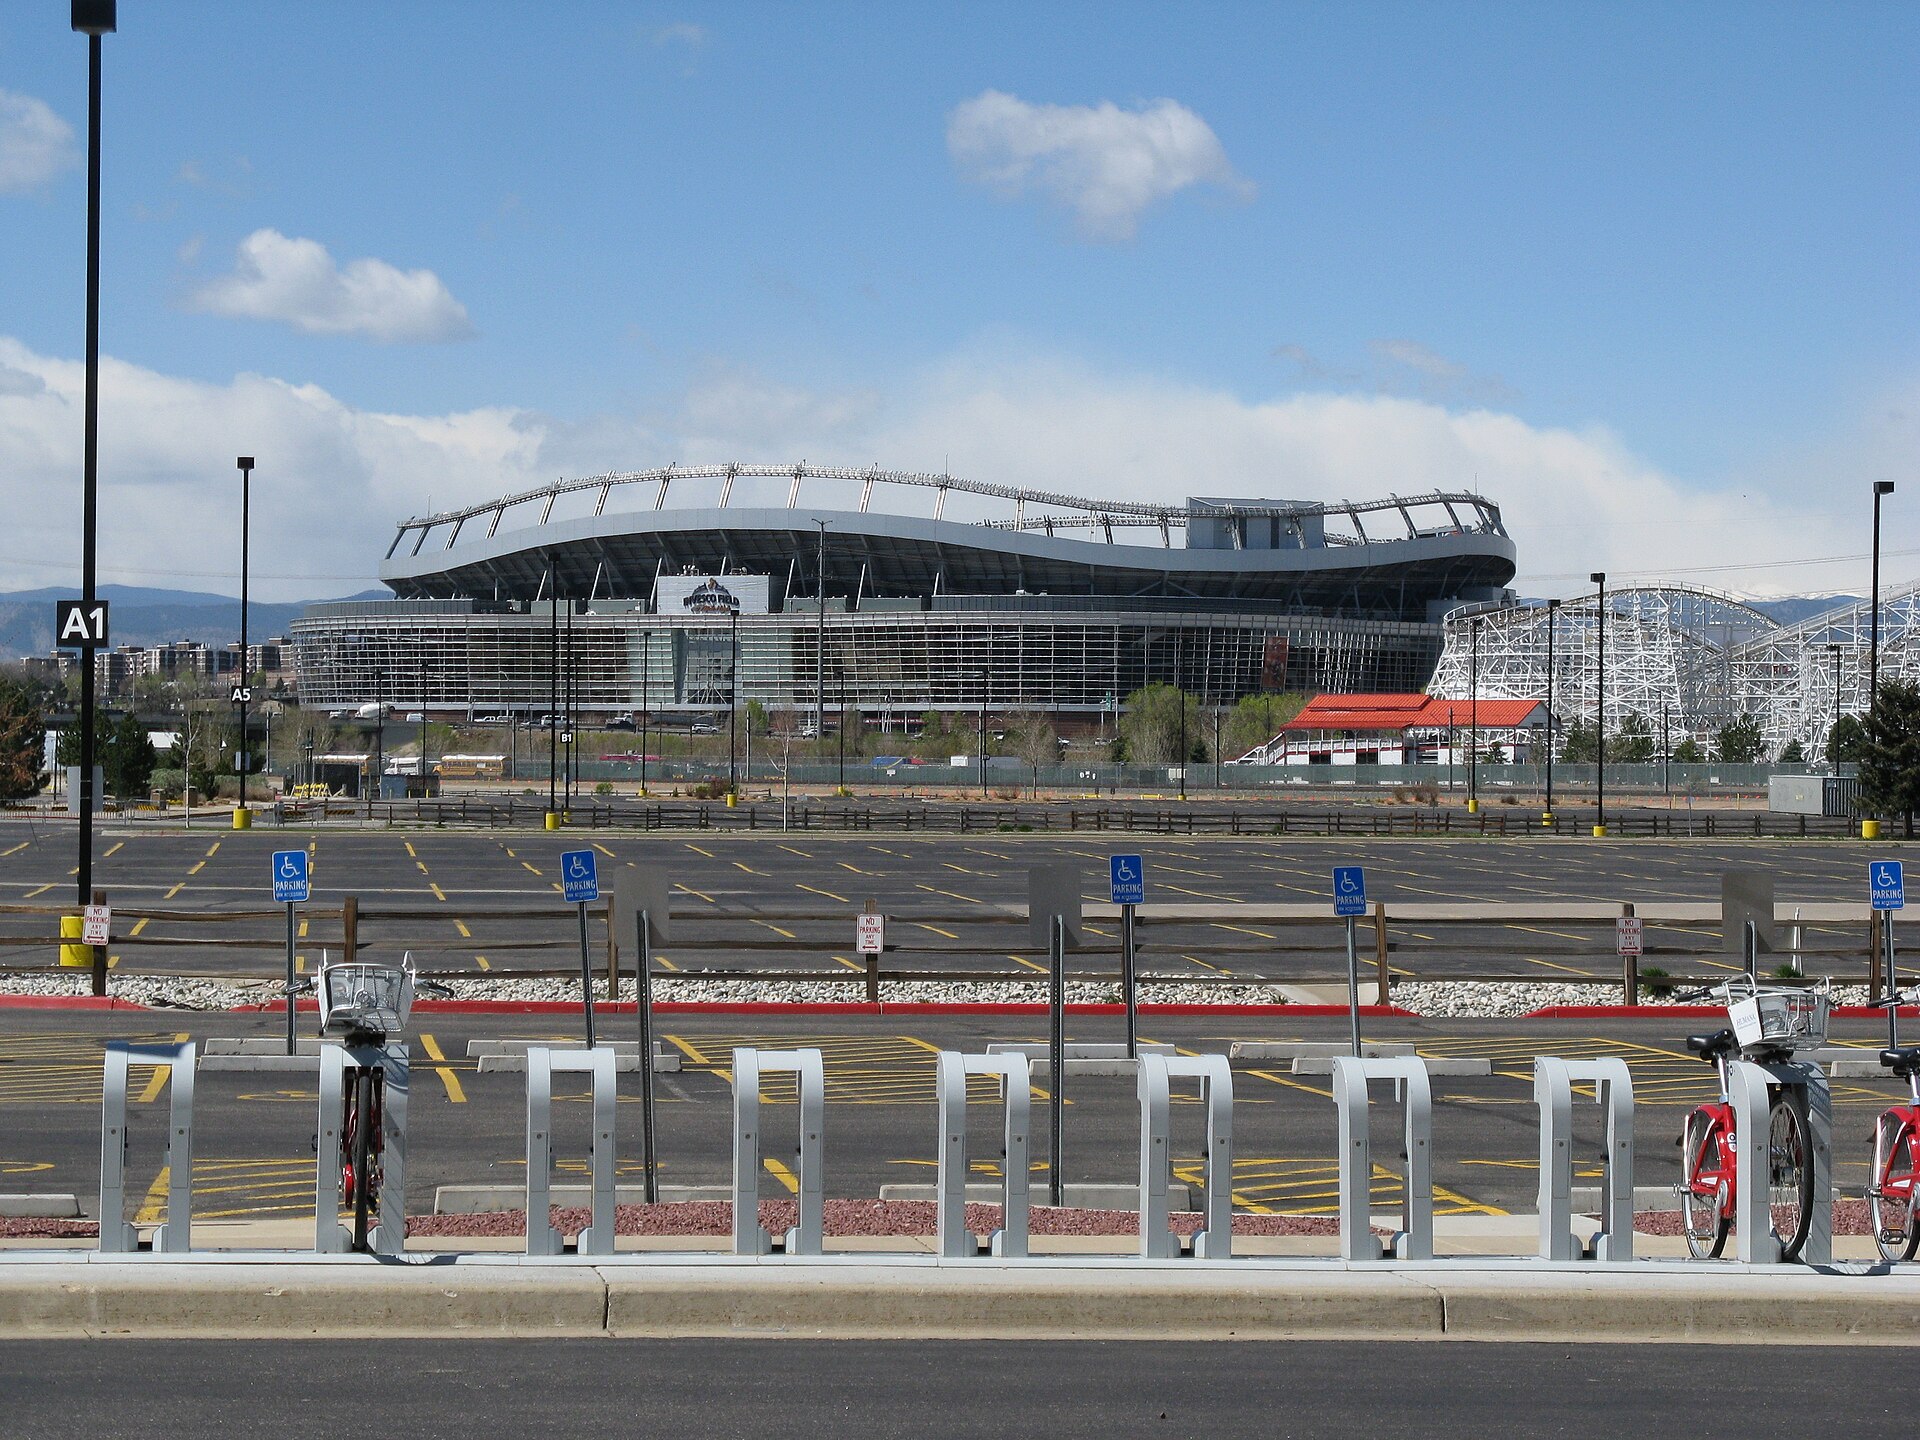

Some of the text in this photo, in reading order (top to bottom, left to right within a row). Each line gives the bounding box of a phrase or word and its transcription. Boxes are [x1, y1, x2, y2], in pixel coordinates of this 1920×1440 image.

[61, 607, 103, 639] A1
[231, 688, 251, 701] A5
[561, 733, 572, 743] B1
[275, 880, 306, 891] PARKING
[565, 880, 596, 891] PARKING
[1113, 884, 1142, 894] PARKING
[1872, 889, 1902, 899] PARKING
[1336, 895, 1365, 905] PARKING
[93, 908, 103, 916] NO
[865, 917, 875, 925] NO
[1624, 919, 1634, 927] NO
